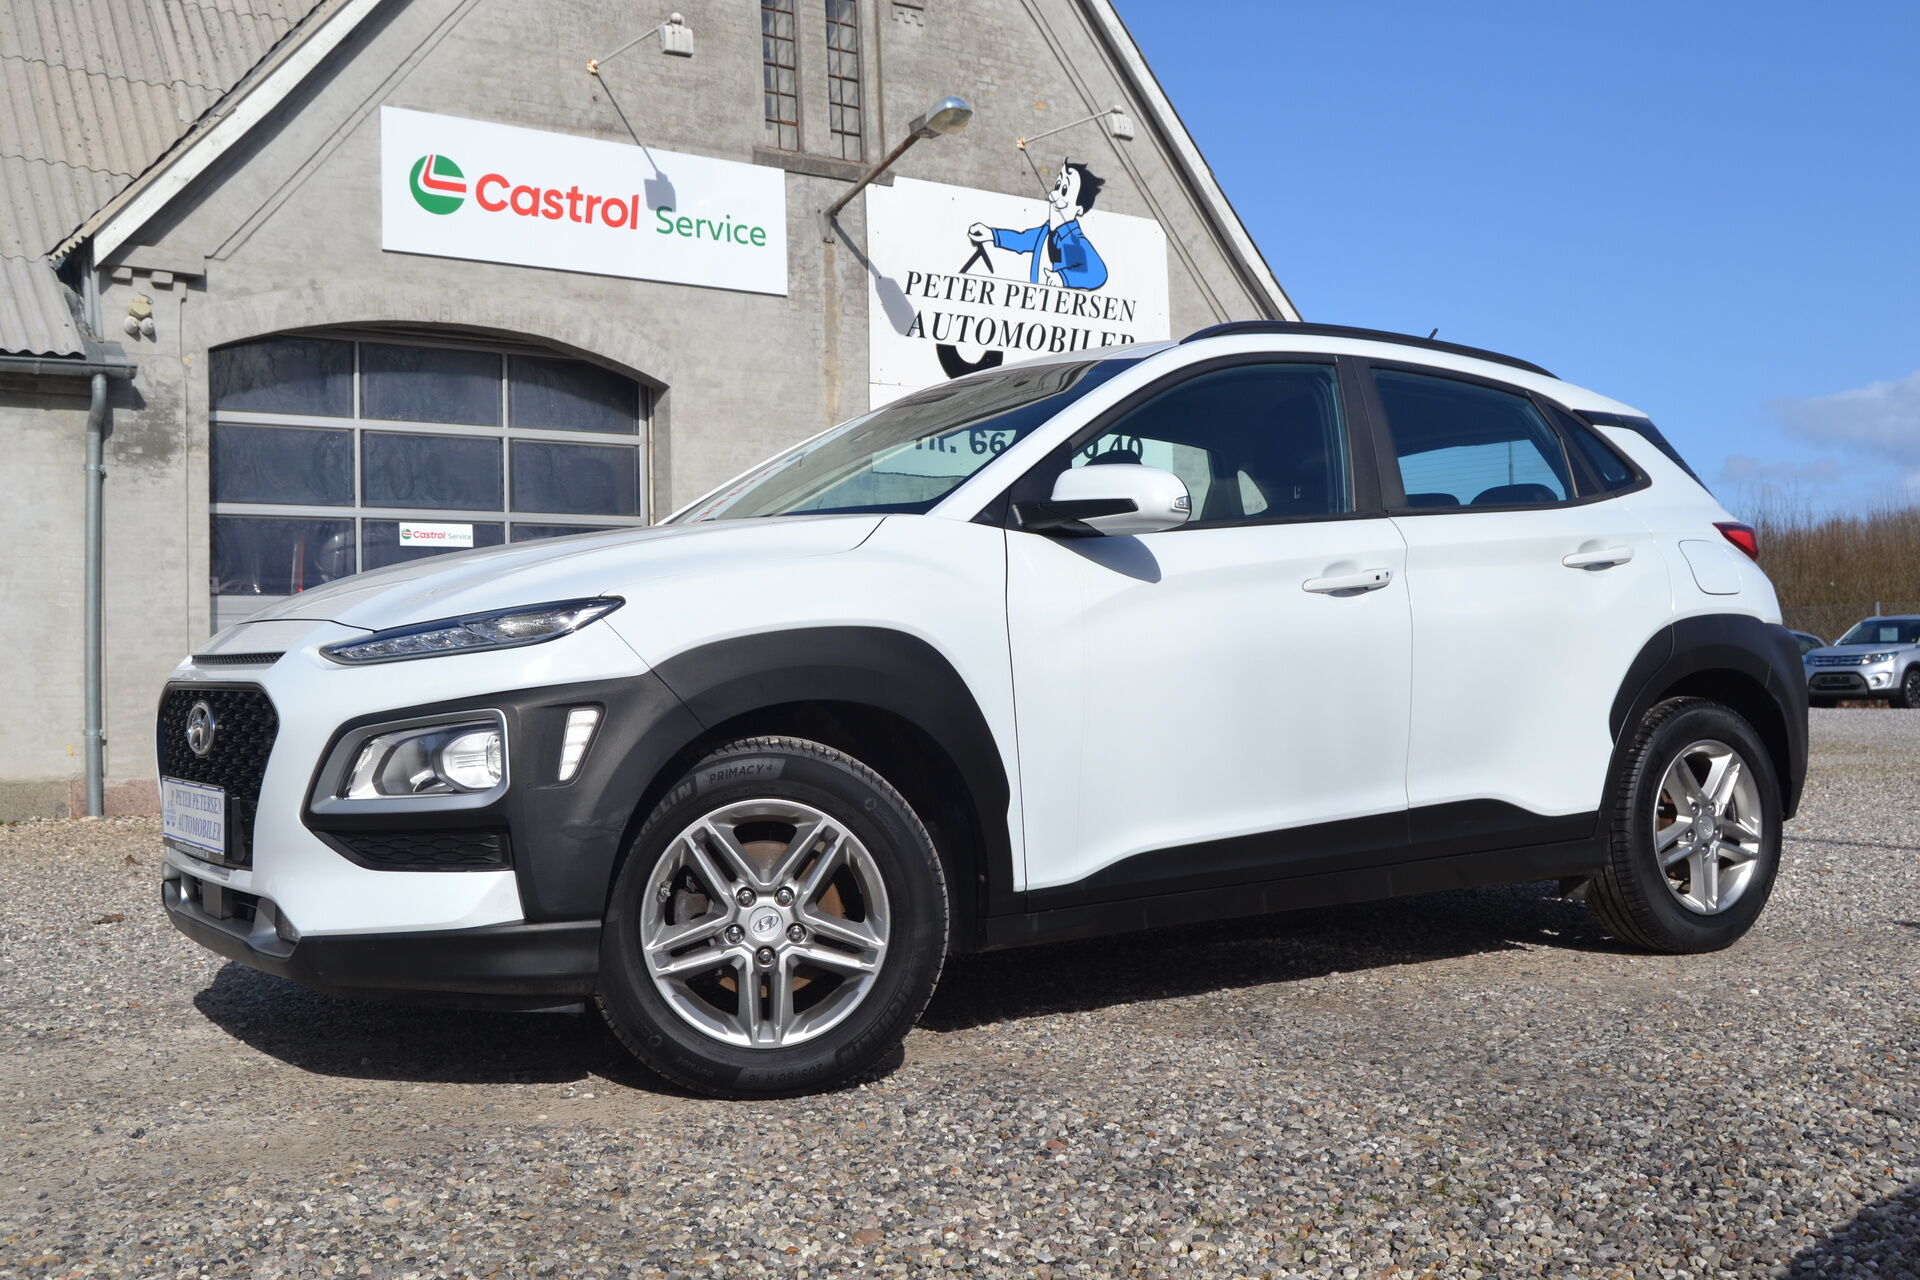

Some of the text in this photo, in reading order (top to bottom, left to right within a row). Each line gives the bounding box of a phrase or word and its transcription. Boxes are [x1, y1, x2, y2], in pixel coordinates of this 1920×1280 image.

[475, 173, 767, 247] Castrol Service
[904, 270, 1137, 323] PETER PETERSEN
[413, 530, 472, 540] Castrol Service
[709, 764, 765, 785] PRIMACY
[175, 789, 222, 814] PETER PETERSEN
[177, 812, 221, 842] AUTOMOBILER
